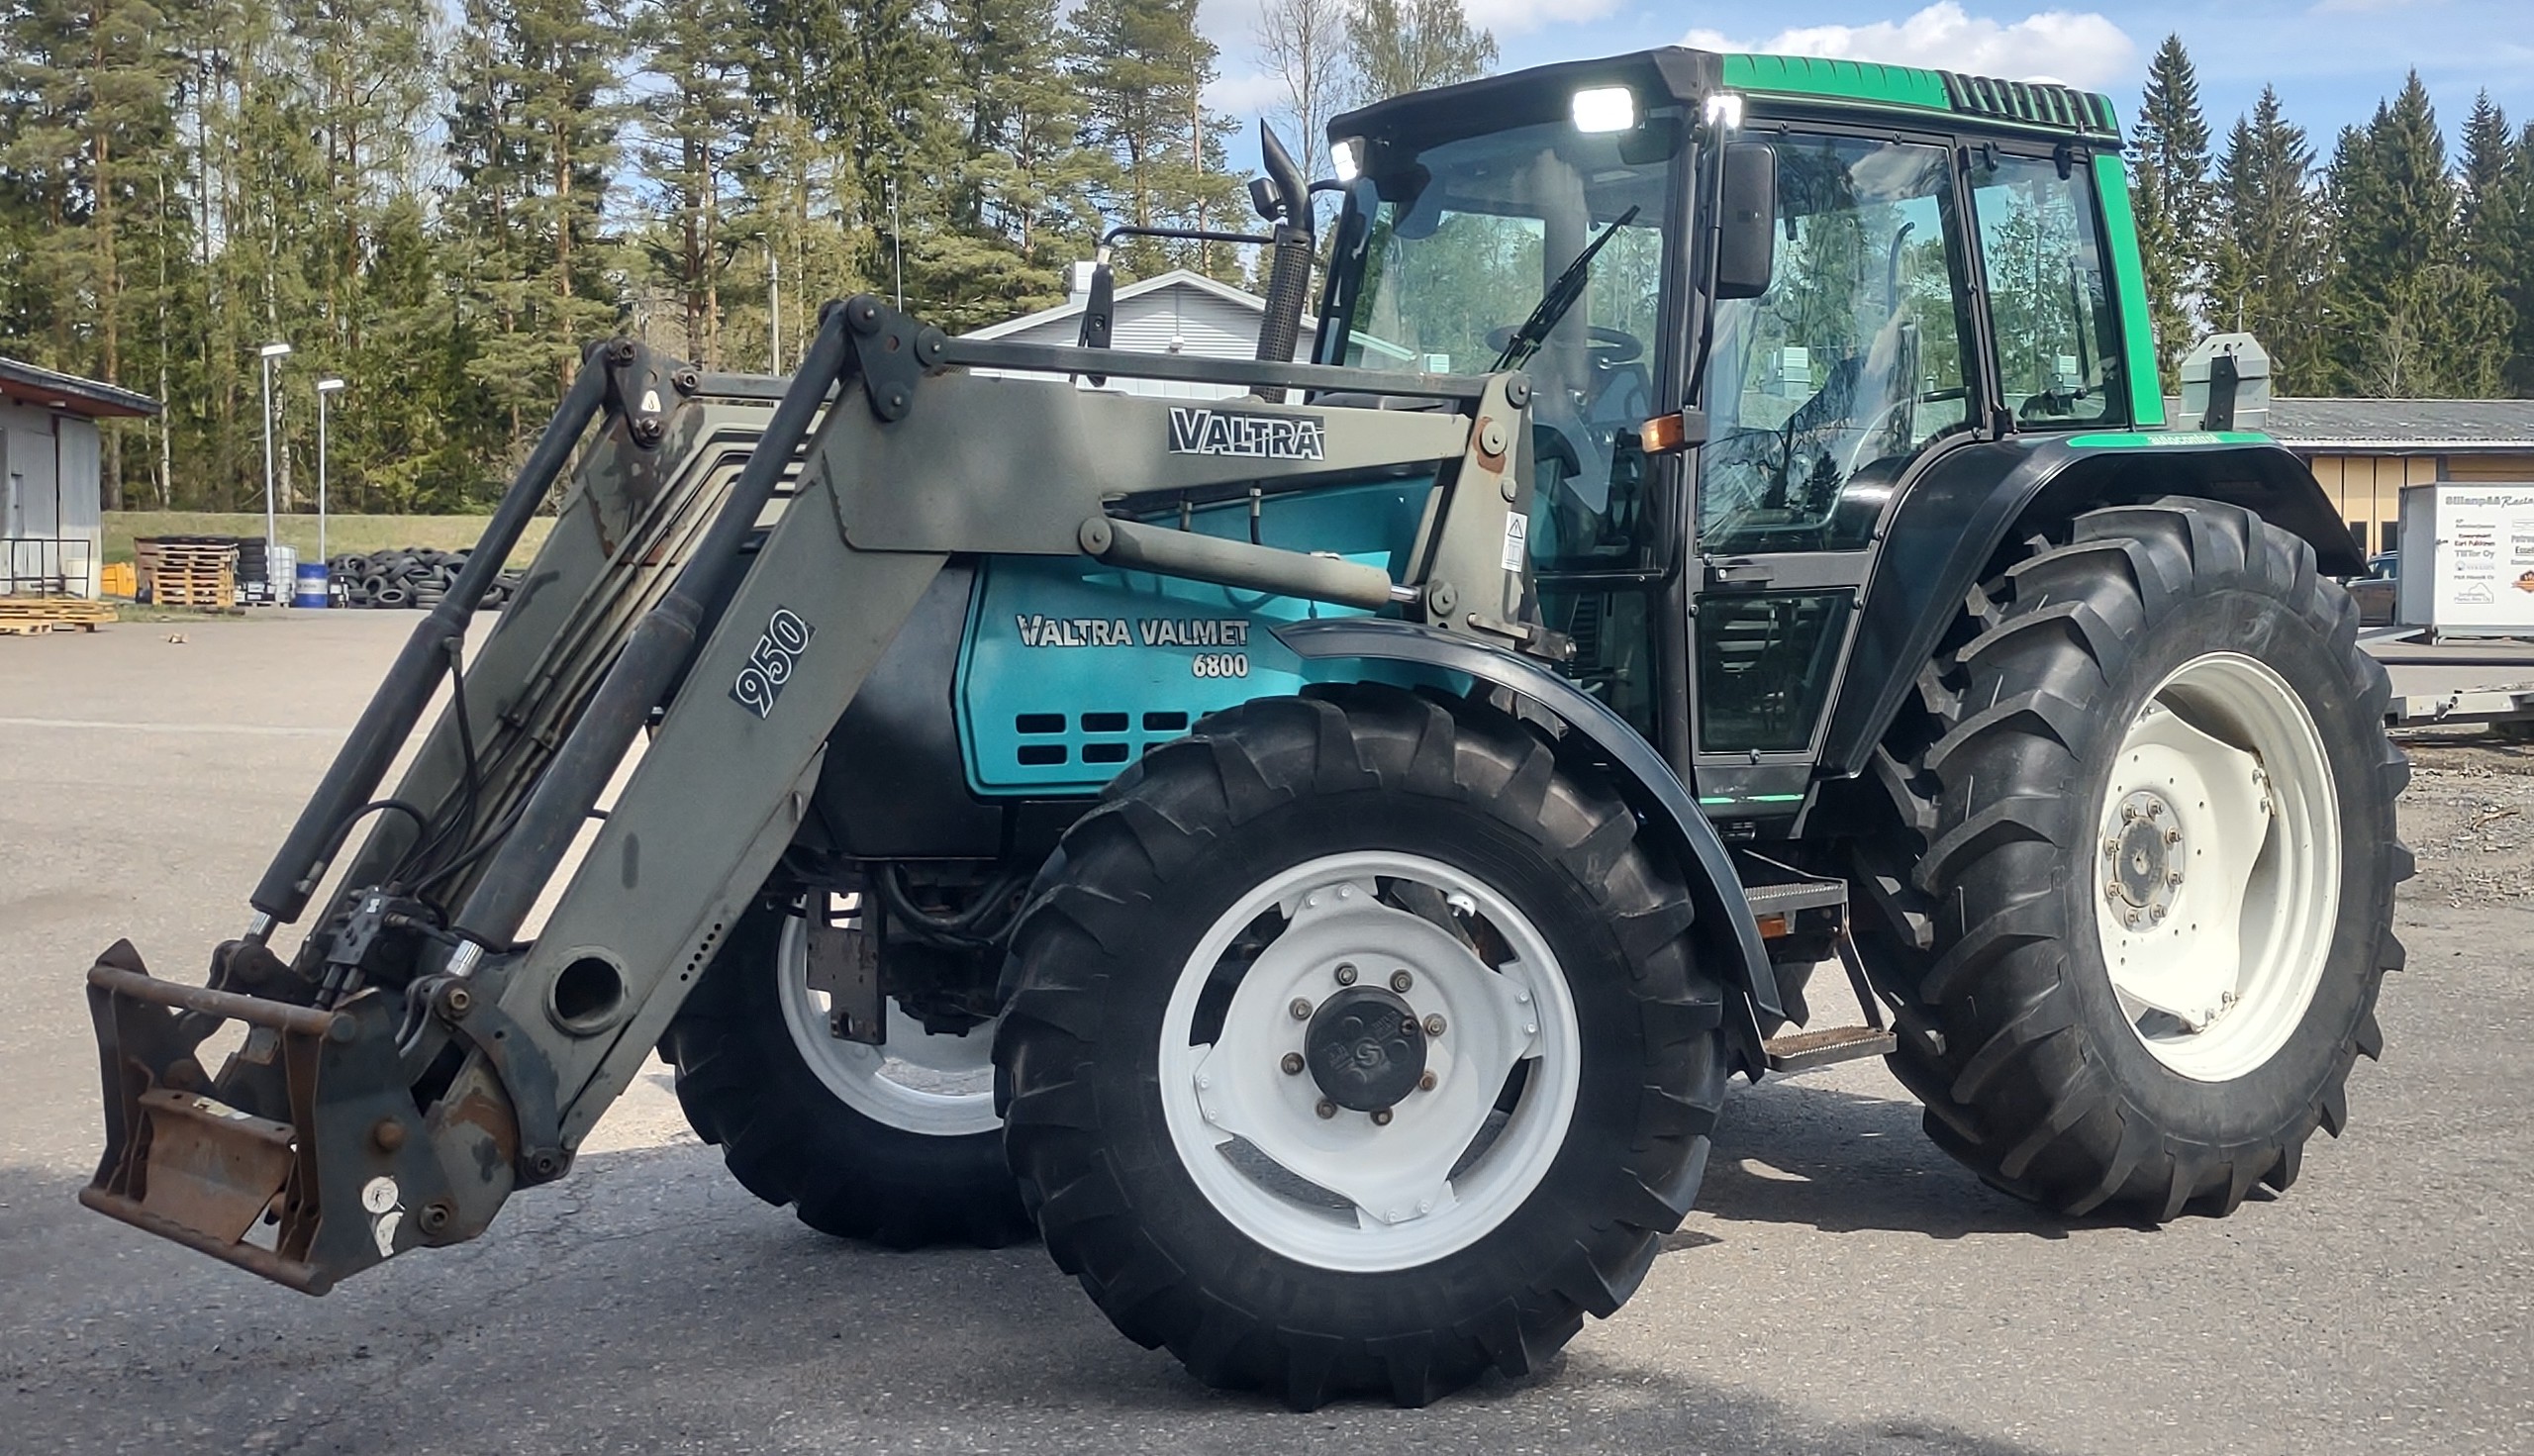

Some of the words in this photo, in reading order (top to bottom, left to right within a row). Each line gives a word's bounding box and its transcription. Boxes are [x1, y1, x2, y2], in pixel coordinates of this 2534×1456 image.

[1169, 407, 1324, 460] VALTRA
[1016, 614, 1134, 646] VALTRA
[1137, 618, 1250, 646] VALMET
[735, 609, 809, 719] 950
[1192, 652, 1250, 679] 6800
